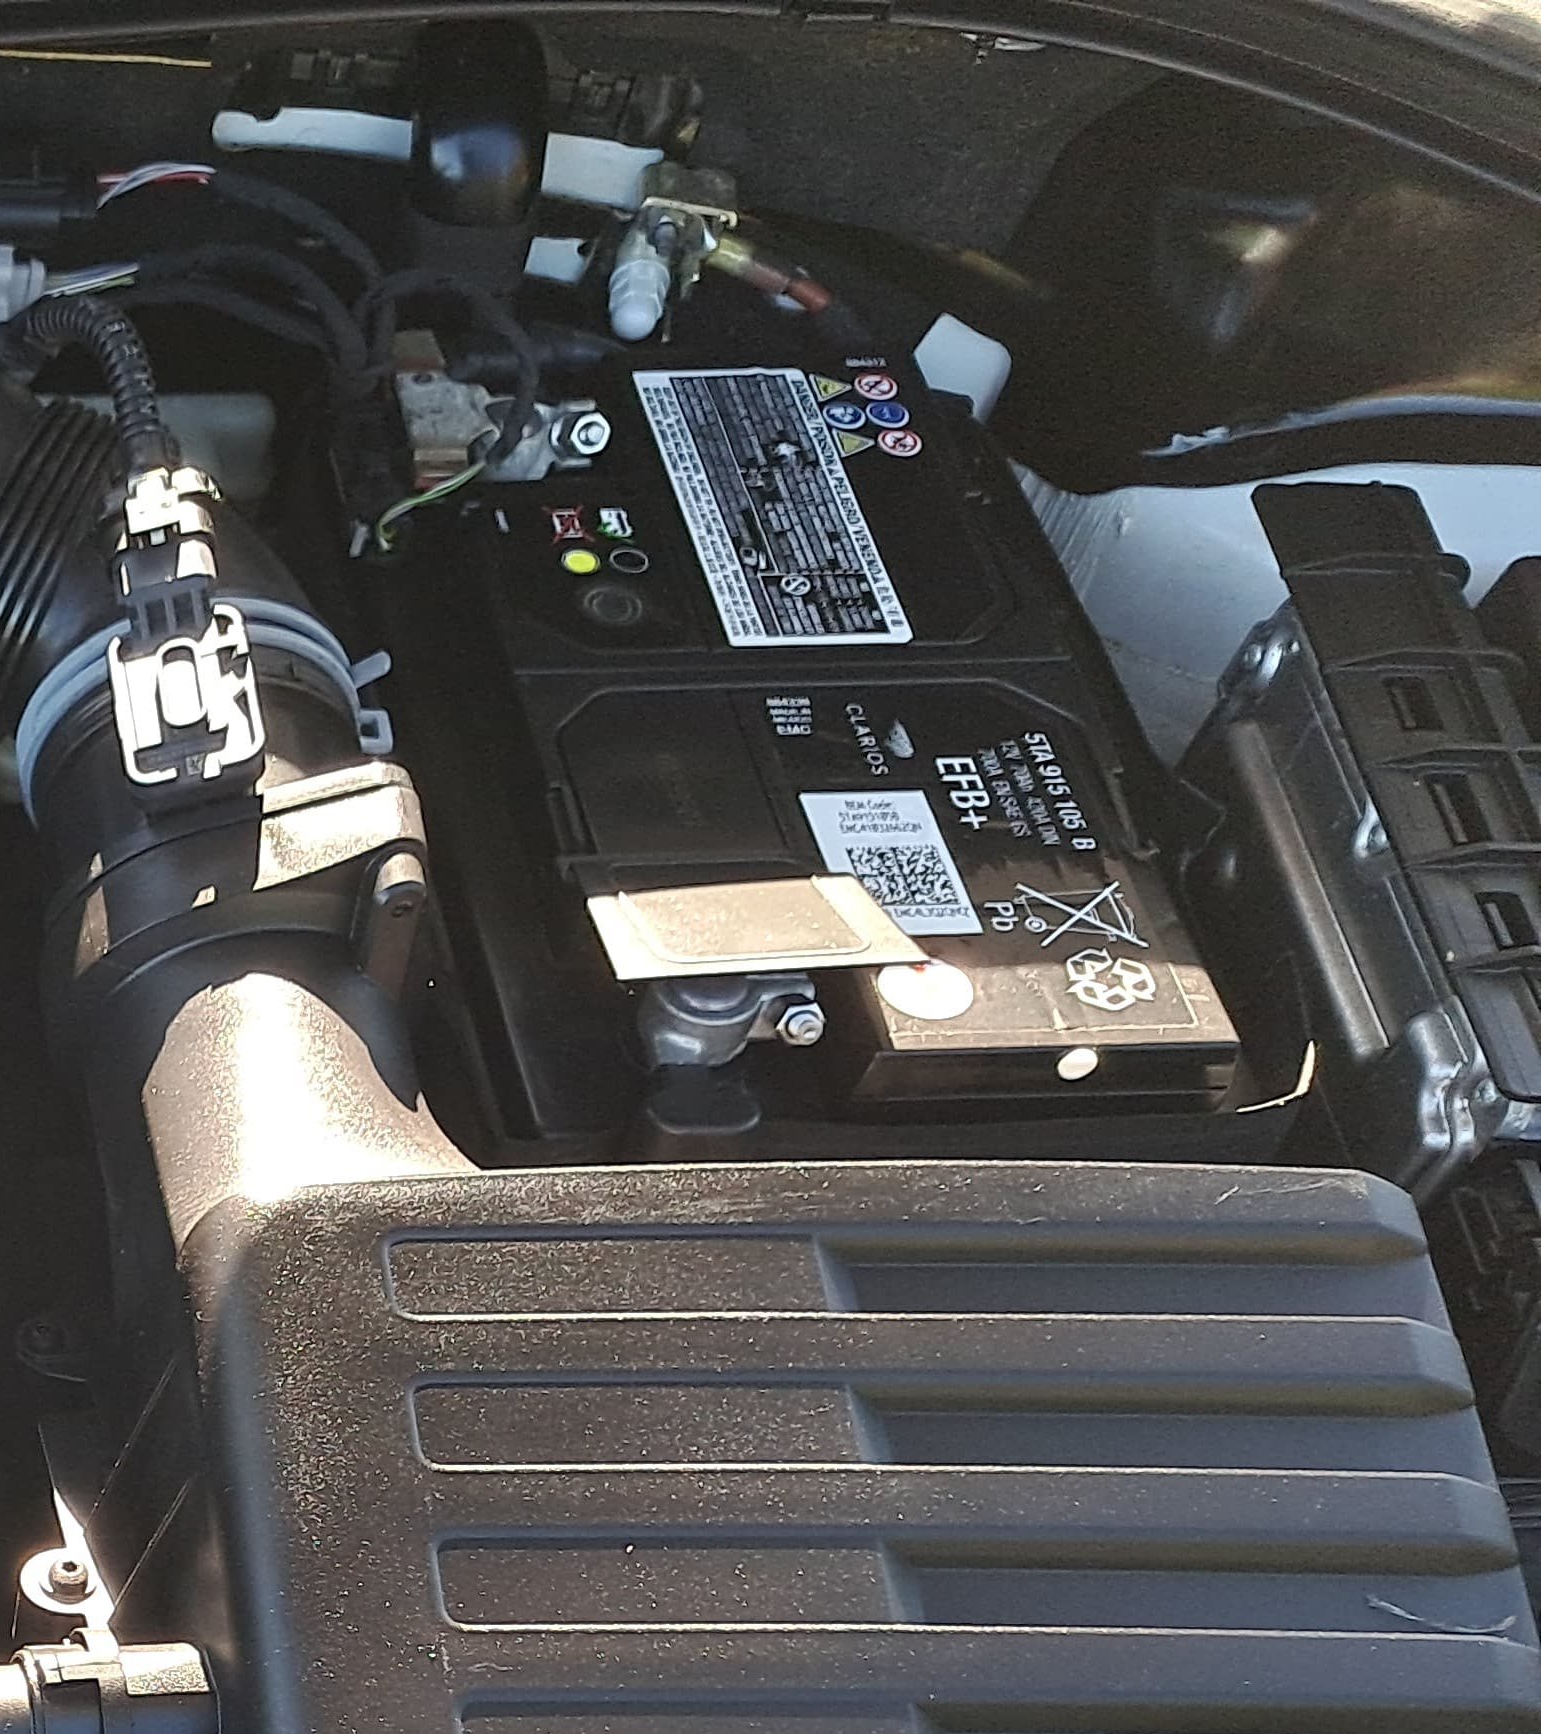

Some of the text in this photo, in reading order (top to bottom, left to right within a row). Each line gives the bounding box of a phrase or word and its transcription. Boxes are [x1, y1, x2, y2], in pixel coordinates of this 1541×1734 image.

[844, 702, 889, 777] CLARIOS
[935, 755, 992, 830] EFB+
[1024, 732, 1097, 850] 5TA 915 105 B
[984, 900, 1016, 932] Pb
